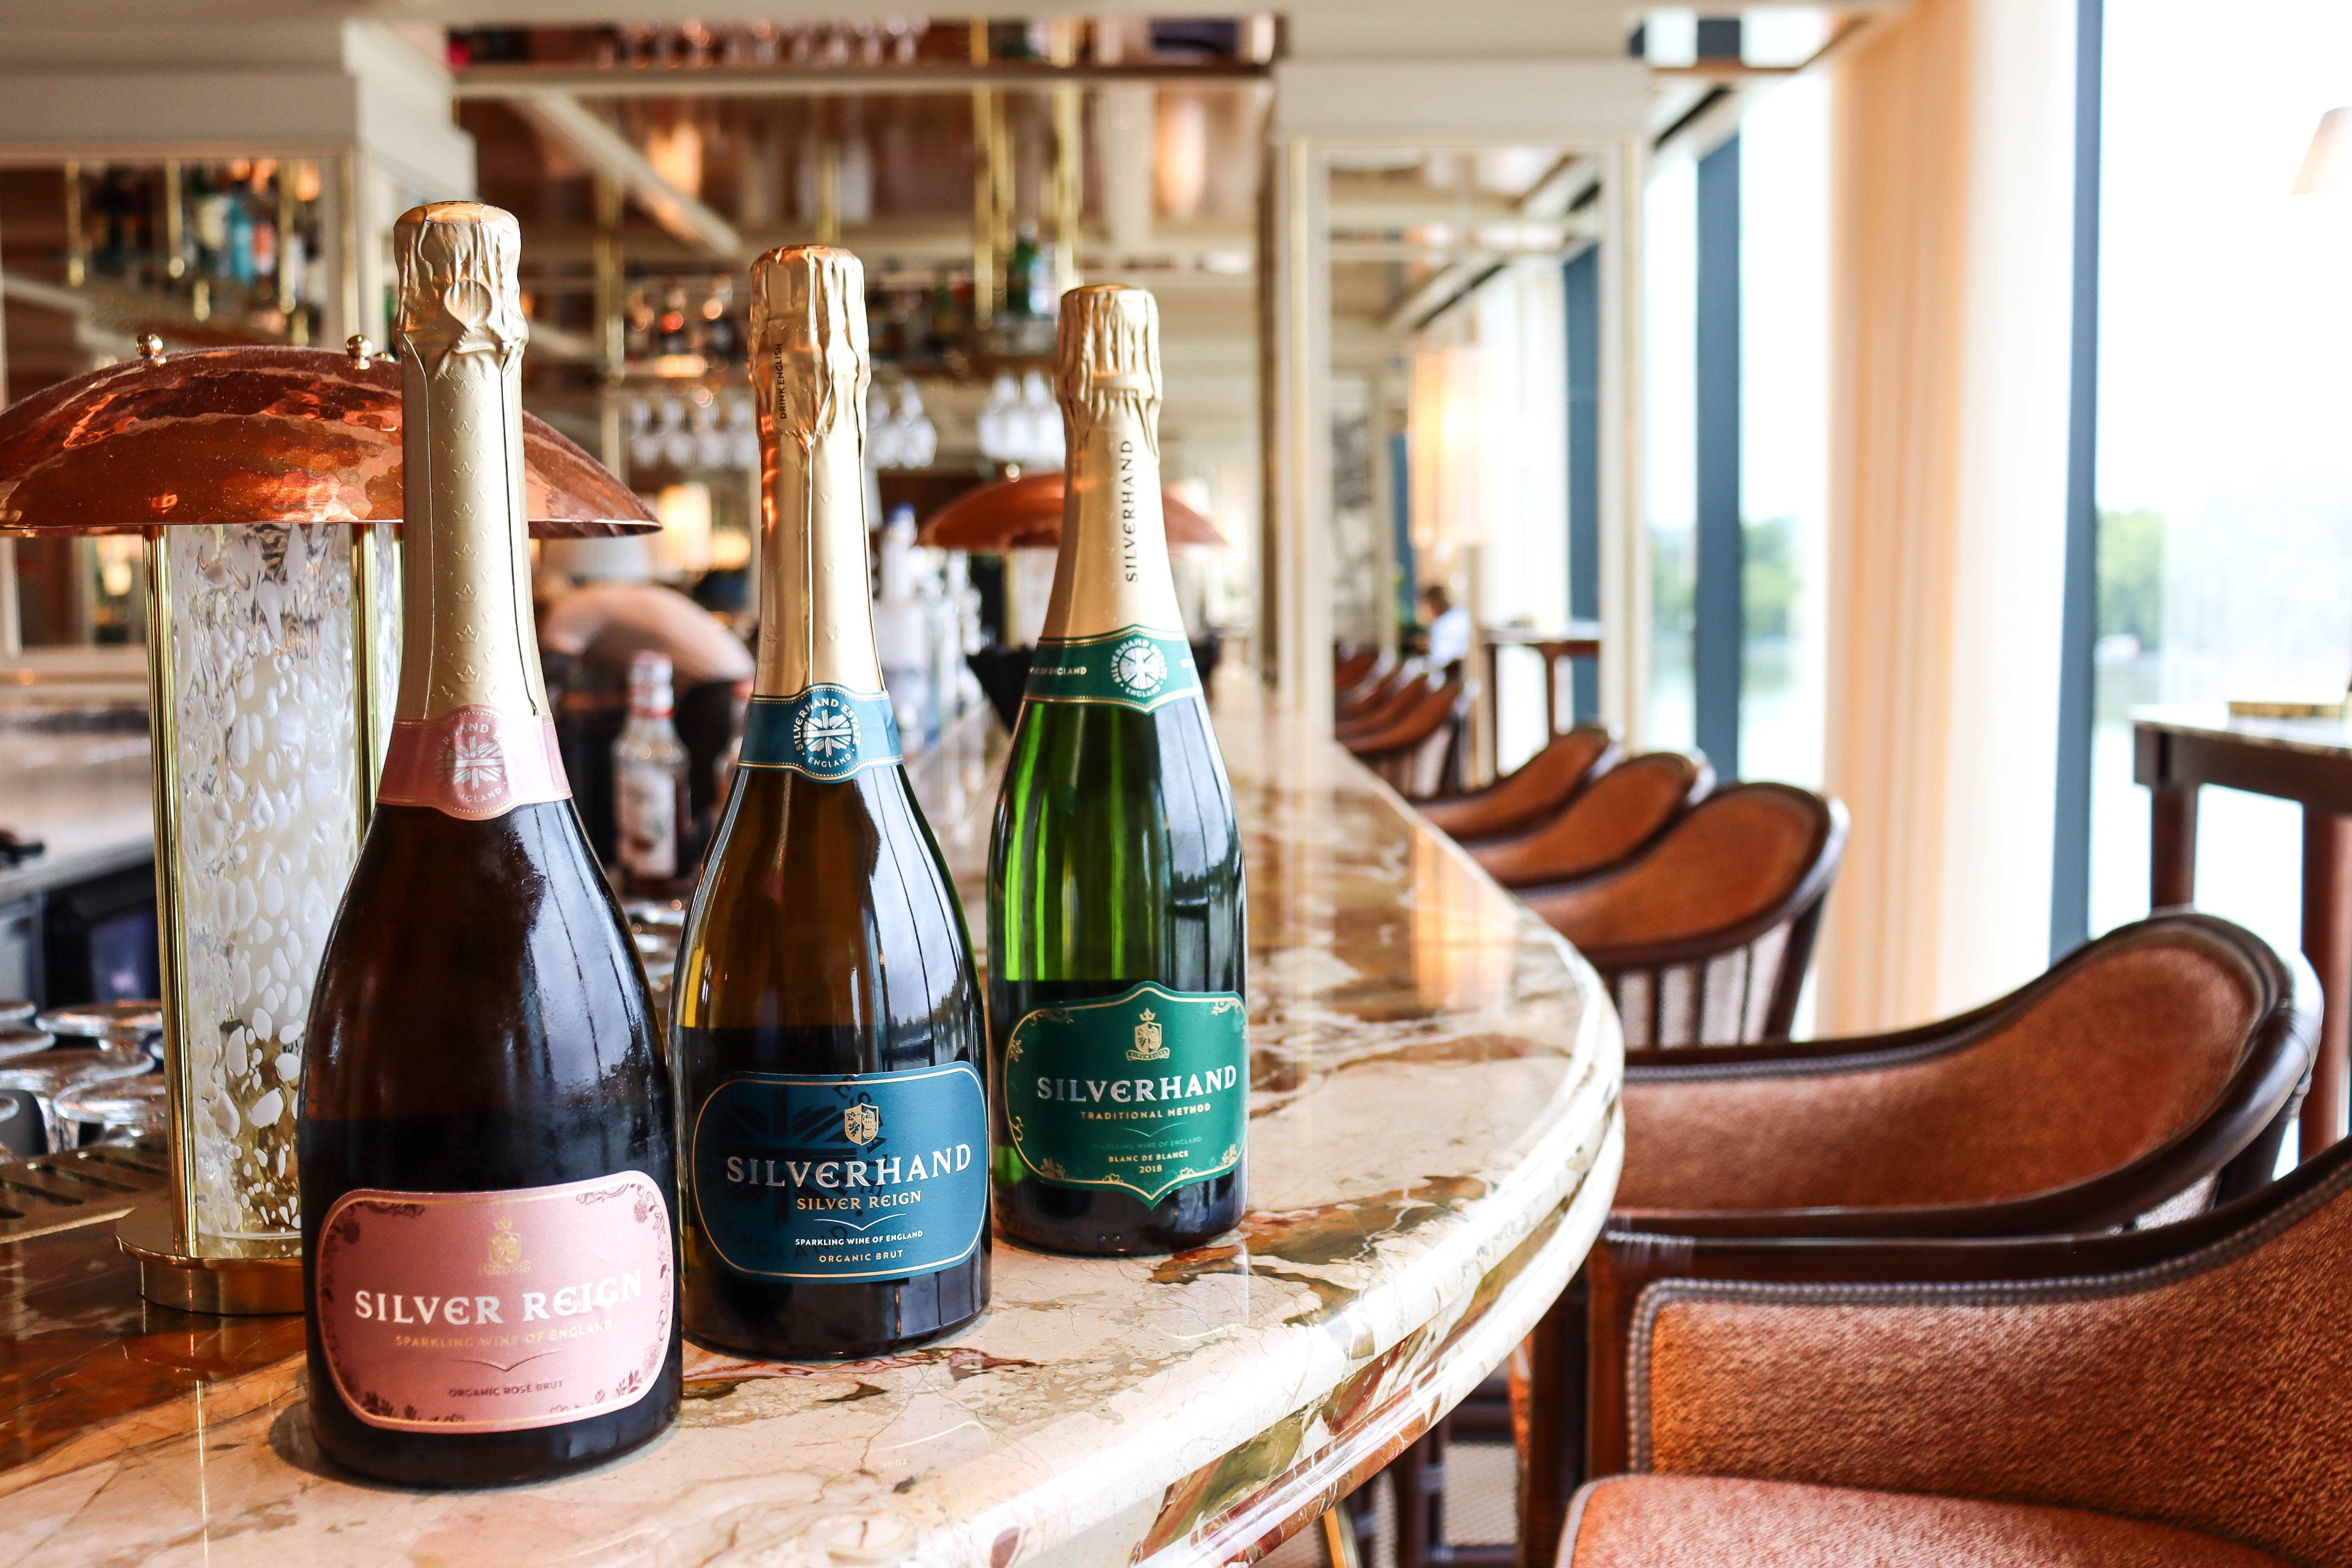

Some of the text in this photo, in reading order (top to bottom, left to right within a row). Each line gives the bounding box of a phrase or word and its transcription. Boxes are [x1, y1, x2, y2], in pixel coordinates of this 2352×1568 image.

[775, 344, 787, 419] DRINK ENGLISH
[1120, 440, 1138, 583] SILVERHAND
[793, 698, 862, 751] SILVERHAND ESTATE
[808, 753, 852, 768] ENGLAND
[1038, 1065, 1237, 1102] SILVERHAND
[1081, 1103, 1211, 1120] TRADITIONAL METHOD
[1171, 1137, 1202, 1146] ENGLAND
[1156, 1150, 1189, 1161] BLANCS
[726, 1143, 972, 1188] SILVERHAND
[1139, 1165, 1163, 1173] 2018
[797, 1190, 921, 1210] SILVER REIGN
[847, 1237, 870, 1245] WINE
[872, 1235, 883, 1243] OF
[886, 1230, 924, 1242] ENGLAND
[819, 1249, 904, 1263] ORGANIC BRUT
[355, 1269, 642, 1325] SILVER REIGN
[396, 1319, 612, 1347] SPARKLING WINE OF ENGLAND
[449, 1380, 563, 1397] ORGANIC ROSÉ BRUT
